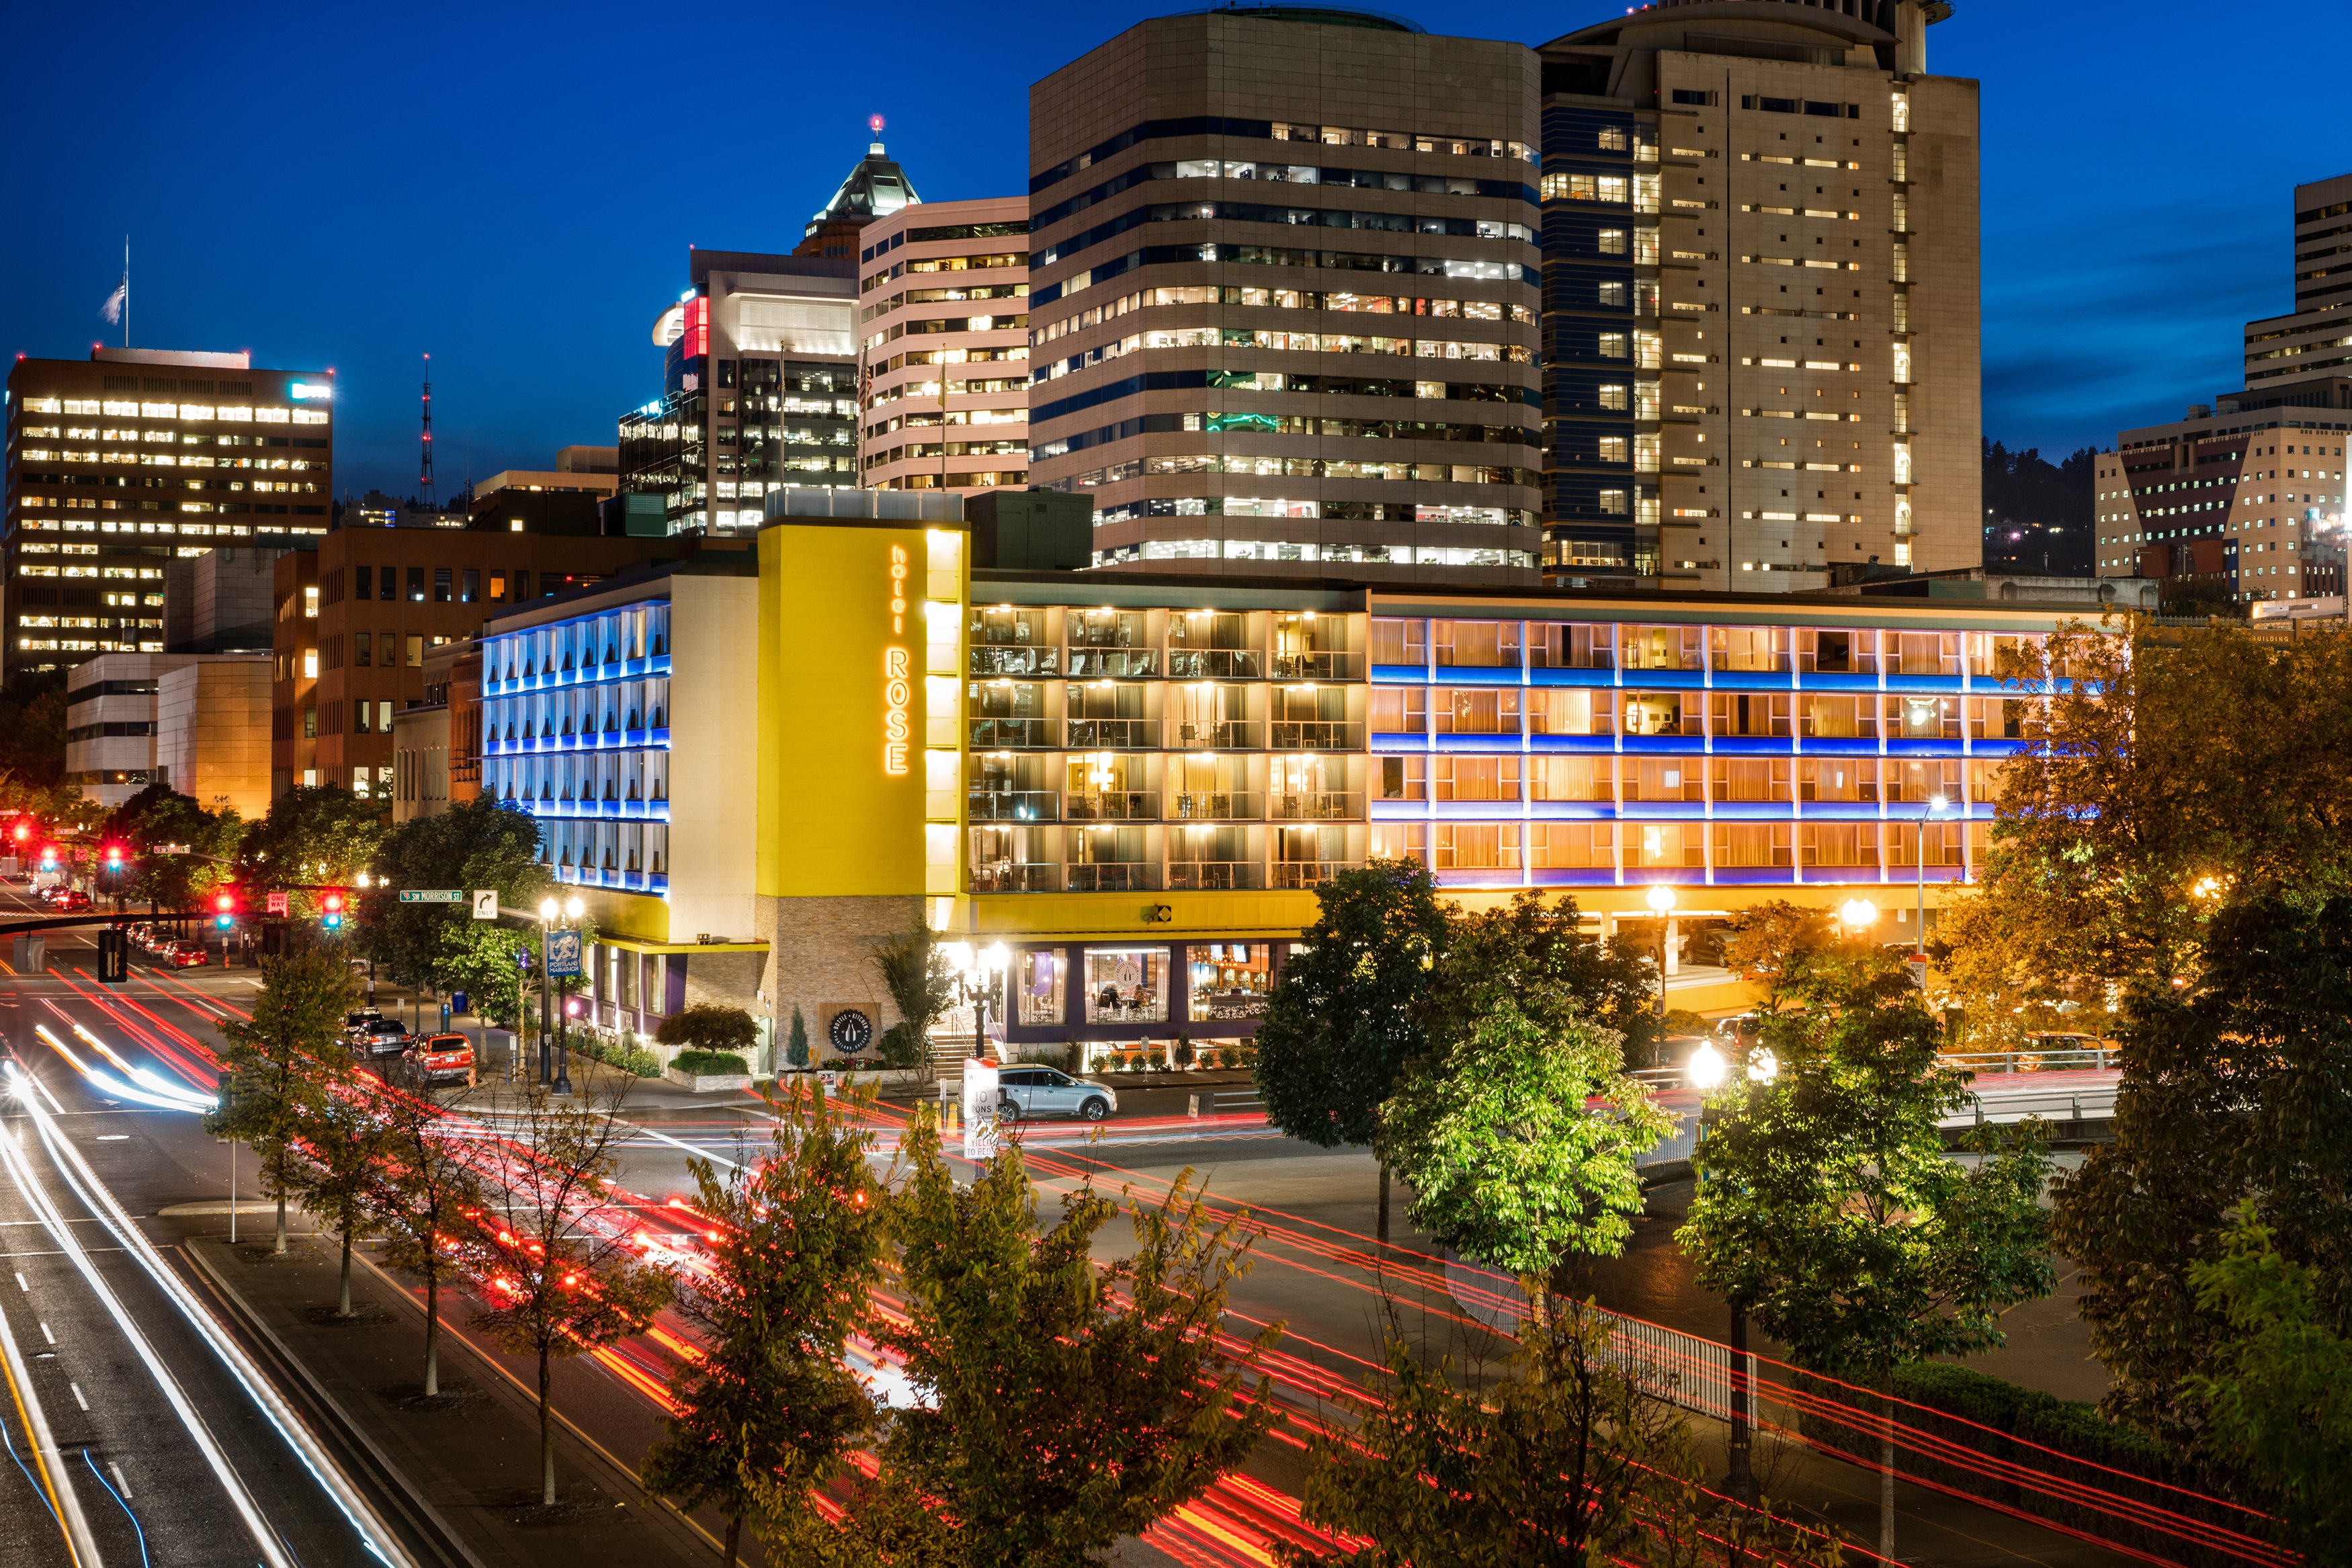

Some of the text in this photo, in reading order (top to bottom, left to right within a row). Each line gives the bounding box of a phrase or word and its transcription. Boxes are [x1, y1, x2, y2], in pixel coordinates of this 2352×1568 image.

[886, 545, 909, 774] hotel ROSE
[421, 891, 452, 901] MORRISON
[833, 1013, 868, 1030] BOTTLE KITCHEN
[968, 1147, 975, 1156] TO
